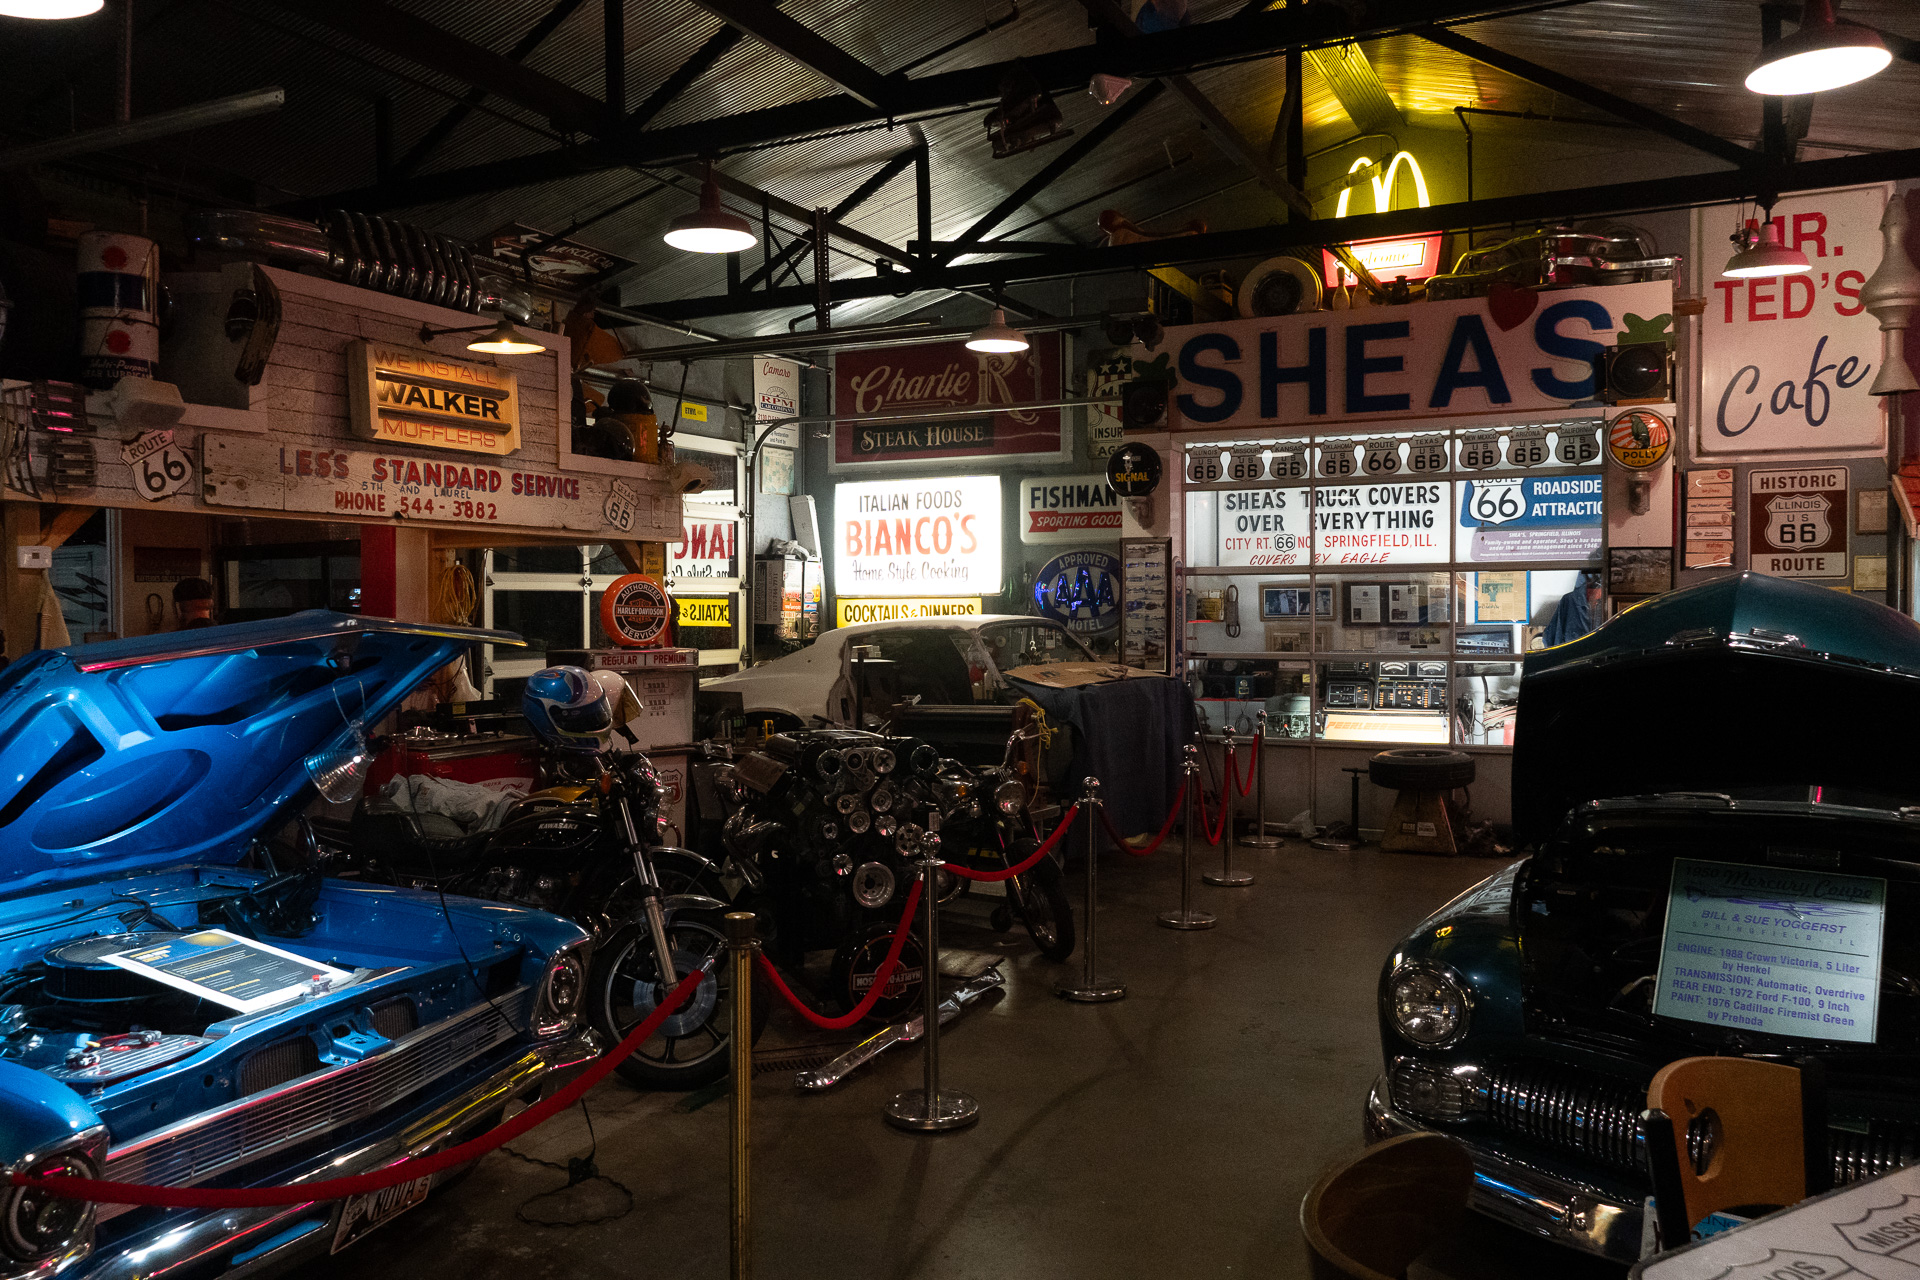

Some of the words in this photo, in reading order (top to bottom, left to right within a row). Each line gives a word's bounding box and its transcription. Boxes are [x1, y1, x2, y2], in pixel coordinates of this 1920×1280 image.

[1714, 270, 1866, 323] TED'S
[374, 350, 410, 370] WE
[416, 356, 497, 385] INSTALL
[763, 362, 790, 378] Camaro
[850, 363, 972, 414] Charlie
[1717, 335, 1871, 437] Cafe
[376, 380, 500, 420] WALKER
[762, 396, 793, 408] RPM
[384, 419, 496, 448] MUFFLERS
[861, 429, 922, 450] STEAK
[924, 426, 984, 447] HOUSE
[1094, 427, 1122, 438] INSUR
[1516, 430, 1540, 438] ARIZONA
[1560, 426, 1593, 434] CALIFORNIA
[130, 436, 168, 460] ROUTE
[1233, 446, 1260, 454] MISSOURI
[1515, 447, 1541, 462] 66
[1564, 444, 1592, 460] 66
[1622, 450, 1658, 460] POLLY
[1368, 451, 1396, 471] 66
[1415, 454, 1440, 470] 66
[1468, 450, 1494, 466] 66
[143, 451, 186, 493] 66
[1194, 465, 1216, 480] 66
[1234, 464, 1258, 478] 66
[1277, 462, 1300, 476] 66
[1326, 460, 1350, 474] 66
[372, 458, 502, 492] STANDARD
[512, 472, 580, 500] SERVICE
[1116, 472, 1150, 482] SIGNAL
[1760, 474, 1836, 490] HISTORIC
[400, 486, 420, 494] AND
[434, 488, 471, 500] LAUREL
[618, 484, 636, 500] TEXAS
[1534, 480, 1602, 496] ROADSIDE
[335, 490, 386, 512] PHONE
[859, 493, 908, 512] ITALIAN
[916, 490, 962, 510] FOODS
[1030, 484, 1117, 509] FISHMAN
[1226, 490, 1286, 510] SHEA'S
[1300, 488, 1360, 508] TRUCK
[1368, 486, 1440, 506] COVERS
[1478, 487, 1518, 518] 66
[1775, 500, 1821, 510] ILLINOIS
[609, 502, 631, 530] 66
[1036, 515, 1088, 528] SPORTING
[1091, 514, 1122, 526] GOOD
[1238, 515, 1284, 532] OVER
[1309, 510, 1434, 530] EVERYTHING
[846, 512, 977, 556] BIANCO'S
[1780, 523, 1816, 544] 66
[1226, 538, 1251, 550] CITY
[1256, 537, 1272, 550] RT.
[1276, 536, 1294, 548] 66
[1059, 552, 1109, 570] APPROVED
[1250, 554, 1297, 566] COVERS
[1315, 553, 1332, 564] BY
[1340, 552, 1391, 564] EAGLE
[1772, 558, 1825, 572] ROUTE
[853, 560, 884, 581] Home
[888, 562, 916, 582] Style
[922, 558, 969, 582] Cooking
[621, 584, 662, 600] AUTHORIZED
[1054, 566, 1114, 618] AAA
[617, 606, 664, 616] HARLEY-DAVIDSON
[623, 625, 660, 640] SERVICE
[1067, 618, 1104, 631] MOTEL
[602, 656, 638, 666] REGULAR
[654, 654, 686, 664] PREMIUM
[1326, 722, 1390, 730] PEERLESS
[538, 822, 578, 830] KAWASAKI
[1724, 870, 1809, 898] Mercury
[1814, 878, 1873, 900] Coupe
[1702, 910, 1728, 921] BILL
[1732, 914, 1740, 922] &
[1744, 914, 1770, 926] SUE
[1774, 918, 1846, 934] YOGGERST
[1678, 942, 1715, 956] ENGINE:
[1720, 948, 1743, 959] 1988
[1746, 952, 1777, 964] Crown
[1781, 956, 1822, 970] Victoria,
[1826, 962, 1833, 970] 5
[1836, 962, 1860, 974] Liter
[1722, 961, 1734, 972] by
[1736, 962, 1770, 975] Henkel
[1674, 966, 1754, 986] TRANSMISSION:
[1756, 978, 1812, 994] Automatic,
[1815, 986, 1866, 1001] Overdrive
[1672, 979, 1698, 992] REAR
[1702, 984, 1726, 994] END:
[1730, 988, 1753, 998] 1972
[1756, 991, 1779, 1002] Ford
[1782, 994, 1814, 1008] F-100,
[1818, 1000, 1825, 1009] 9
[1828, 1001, 1850, 1012] Inch
[1671, 992, 1703, 1004] PAINT:
[1707, 997, 1730, 1008] 1976
[1734, 1001, 1774, 1015] Cadillac
[1778, 1007, 1820, 1022] Firemist
[1823, 1014, 1855, 1026] Green
[1707, 1010, 1719, 1022] by
[1722, 1012, 1764, 1027] Prehoda
